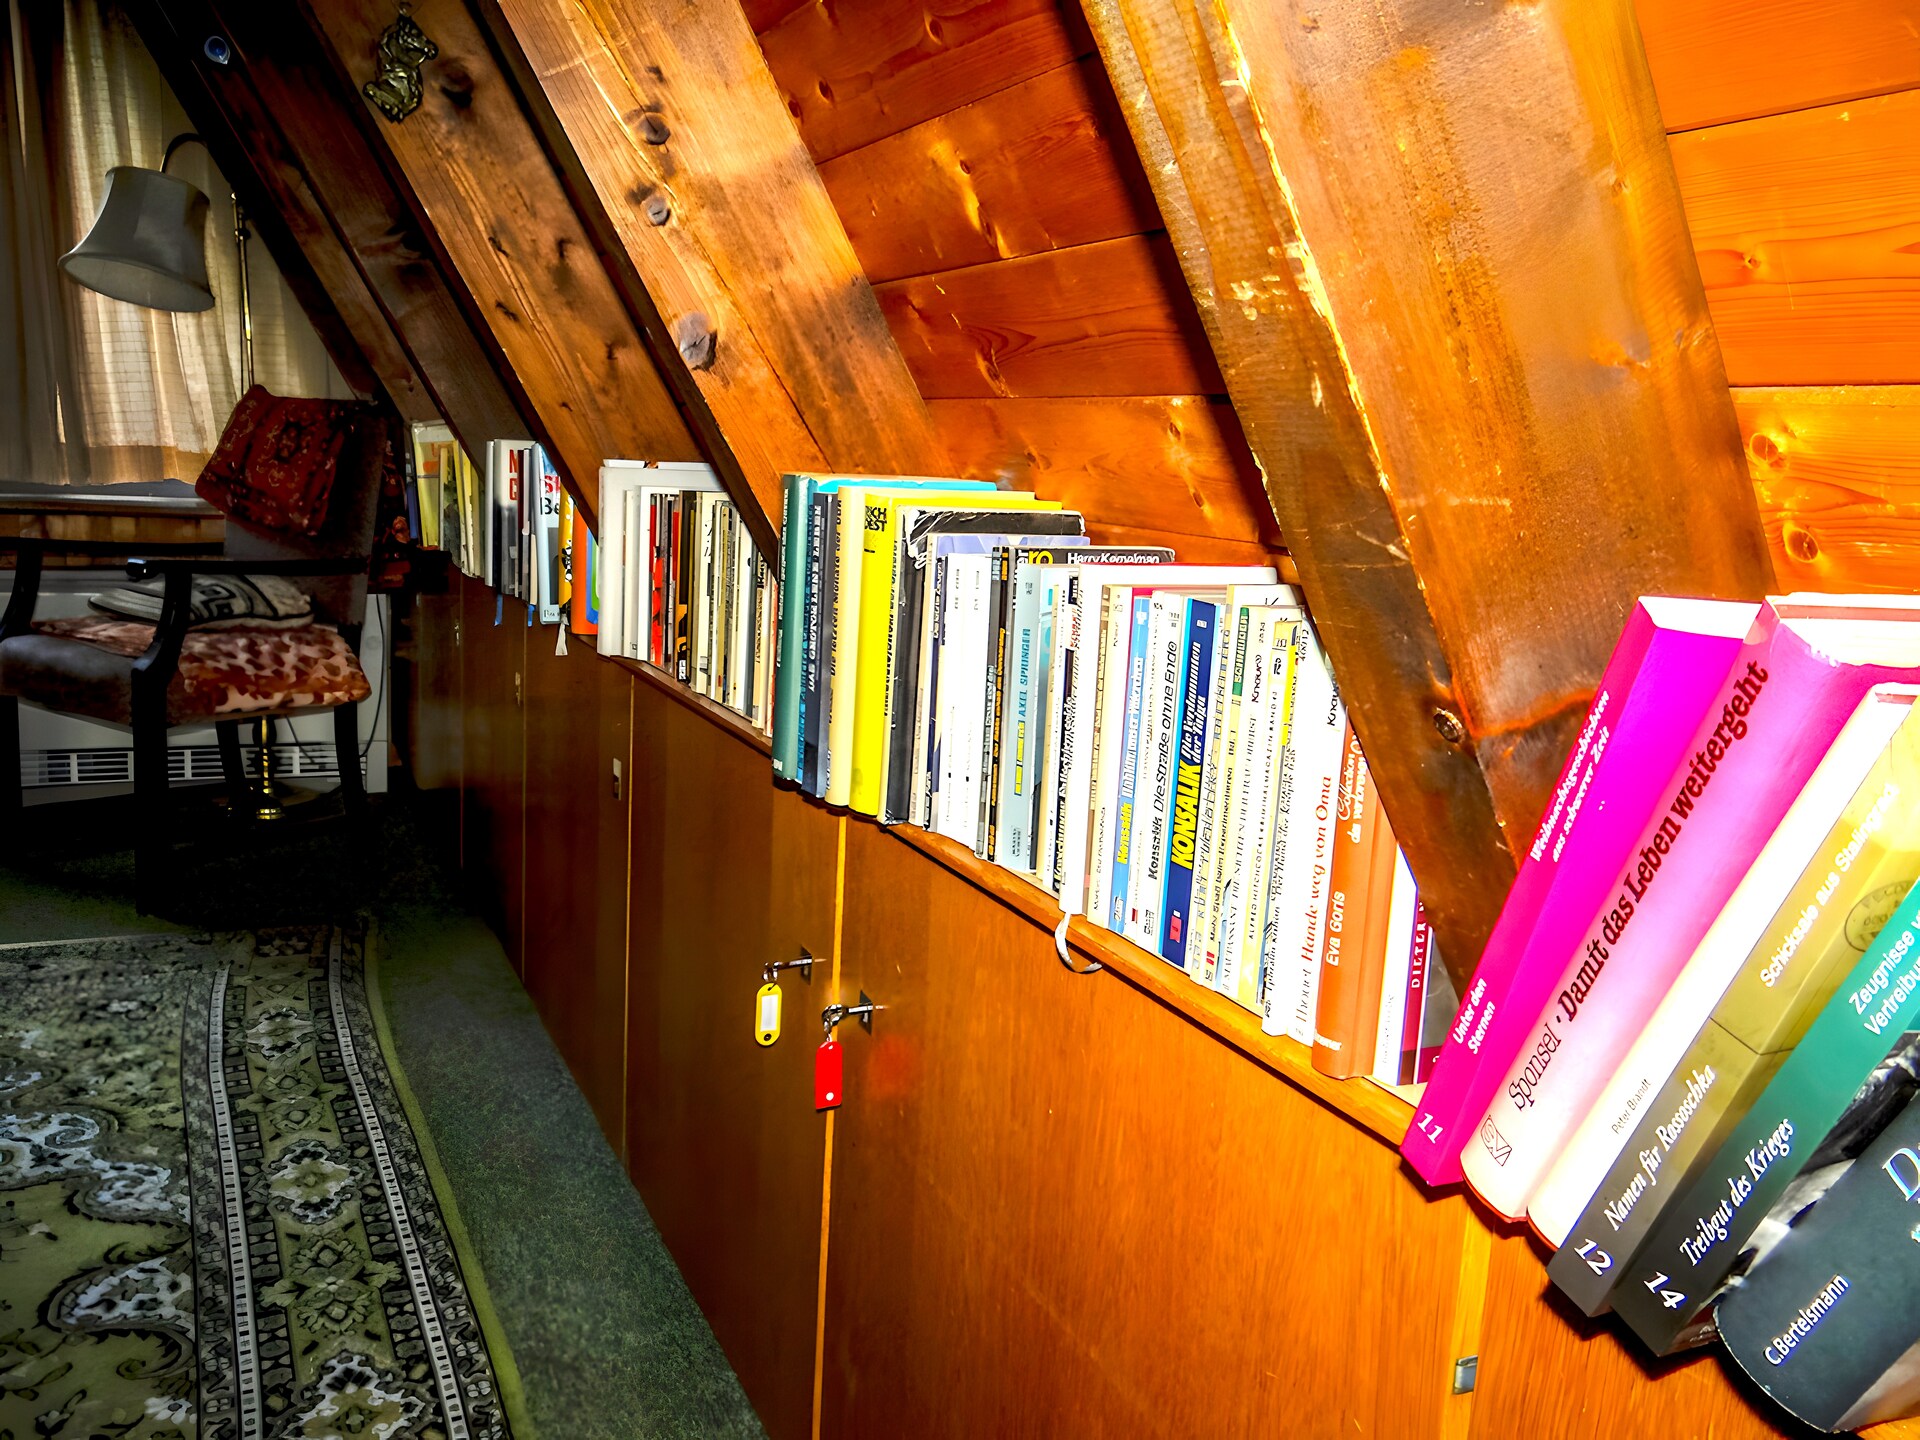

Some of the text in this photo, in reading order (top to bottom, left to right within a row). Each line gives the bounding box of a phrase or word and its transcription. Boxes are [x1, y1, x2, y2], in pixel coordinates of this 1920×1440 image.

[1164, 641, 1178, 683] Ende
[1161, 688, 1174, 730] ohne
[1157, 734, 1171, 785] Straße
[1591, 726, 1610, 764] Zeit
[1171, 760, 1201, 869] KONSALIK
[1315, 776, 1331, 821] Oma
[1148, 818, 1163, 879] Konsalik
[1315, 826, 1327, 858] von
[1311, 865, 1326, 900] weg
[1507, 659, 1770, 1111] Sponsel Damit das Leben weitergeht
[1326, 891, 1346, 965] Eva Goris
[1760, 905, 1820, 988] Schicksale
[1816, 872, 1841, 906] aus
[1848, 930, 1915, 1015] Zeugnisse
[1863, 955, 1920, 1035] Vertreibu
[1452, 977, 1487, 1045] Unter den
[1467, 1000, 1496, 1054] Sternen
[1417, 1114, 1444, 1144] 11
[1611, 1078, 1652, 1135] Peter Brandt
[1604, 1063, 1716, 1231] Namen für Rossoschka
[1679, 1118, 1795, 1267] Treibgut des Krieges
[1574, 1238, 1613, 1276] 12
[1644, 1271, 1686, 1309] 14
[1764, 1274, 1849, 1366] C.Bertelsmann
